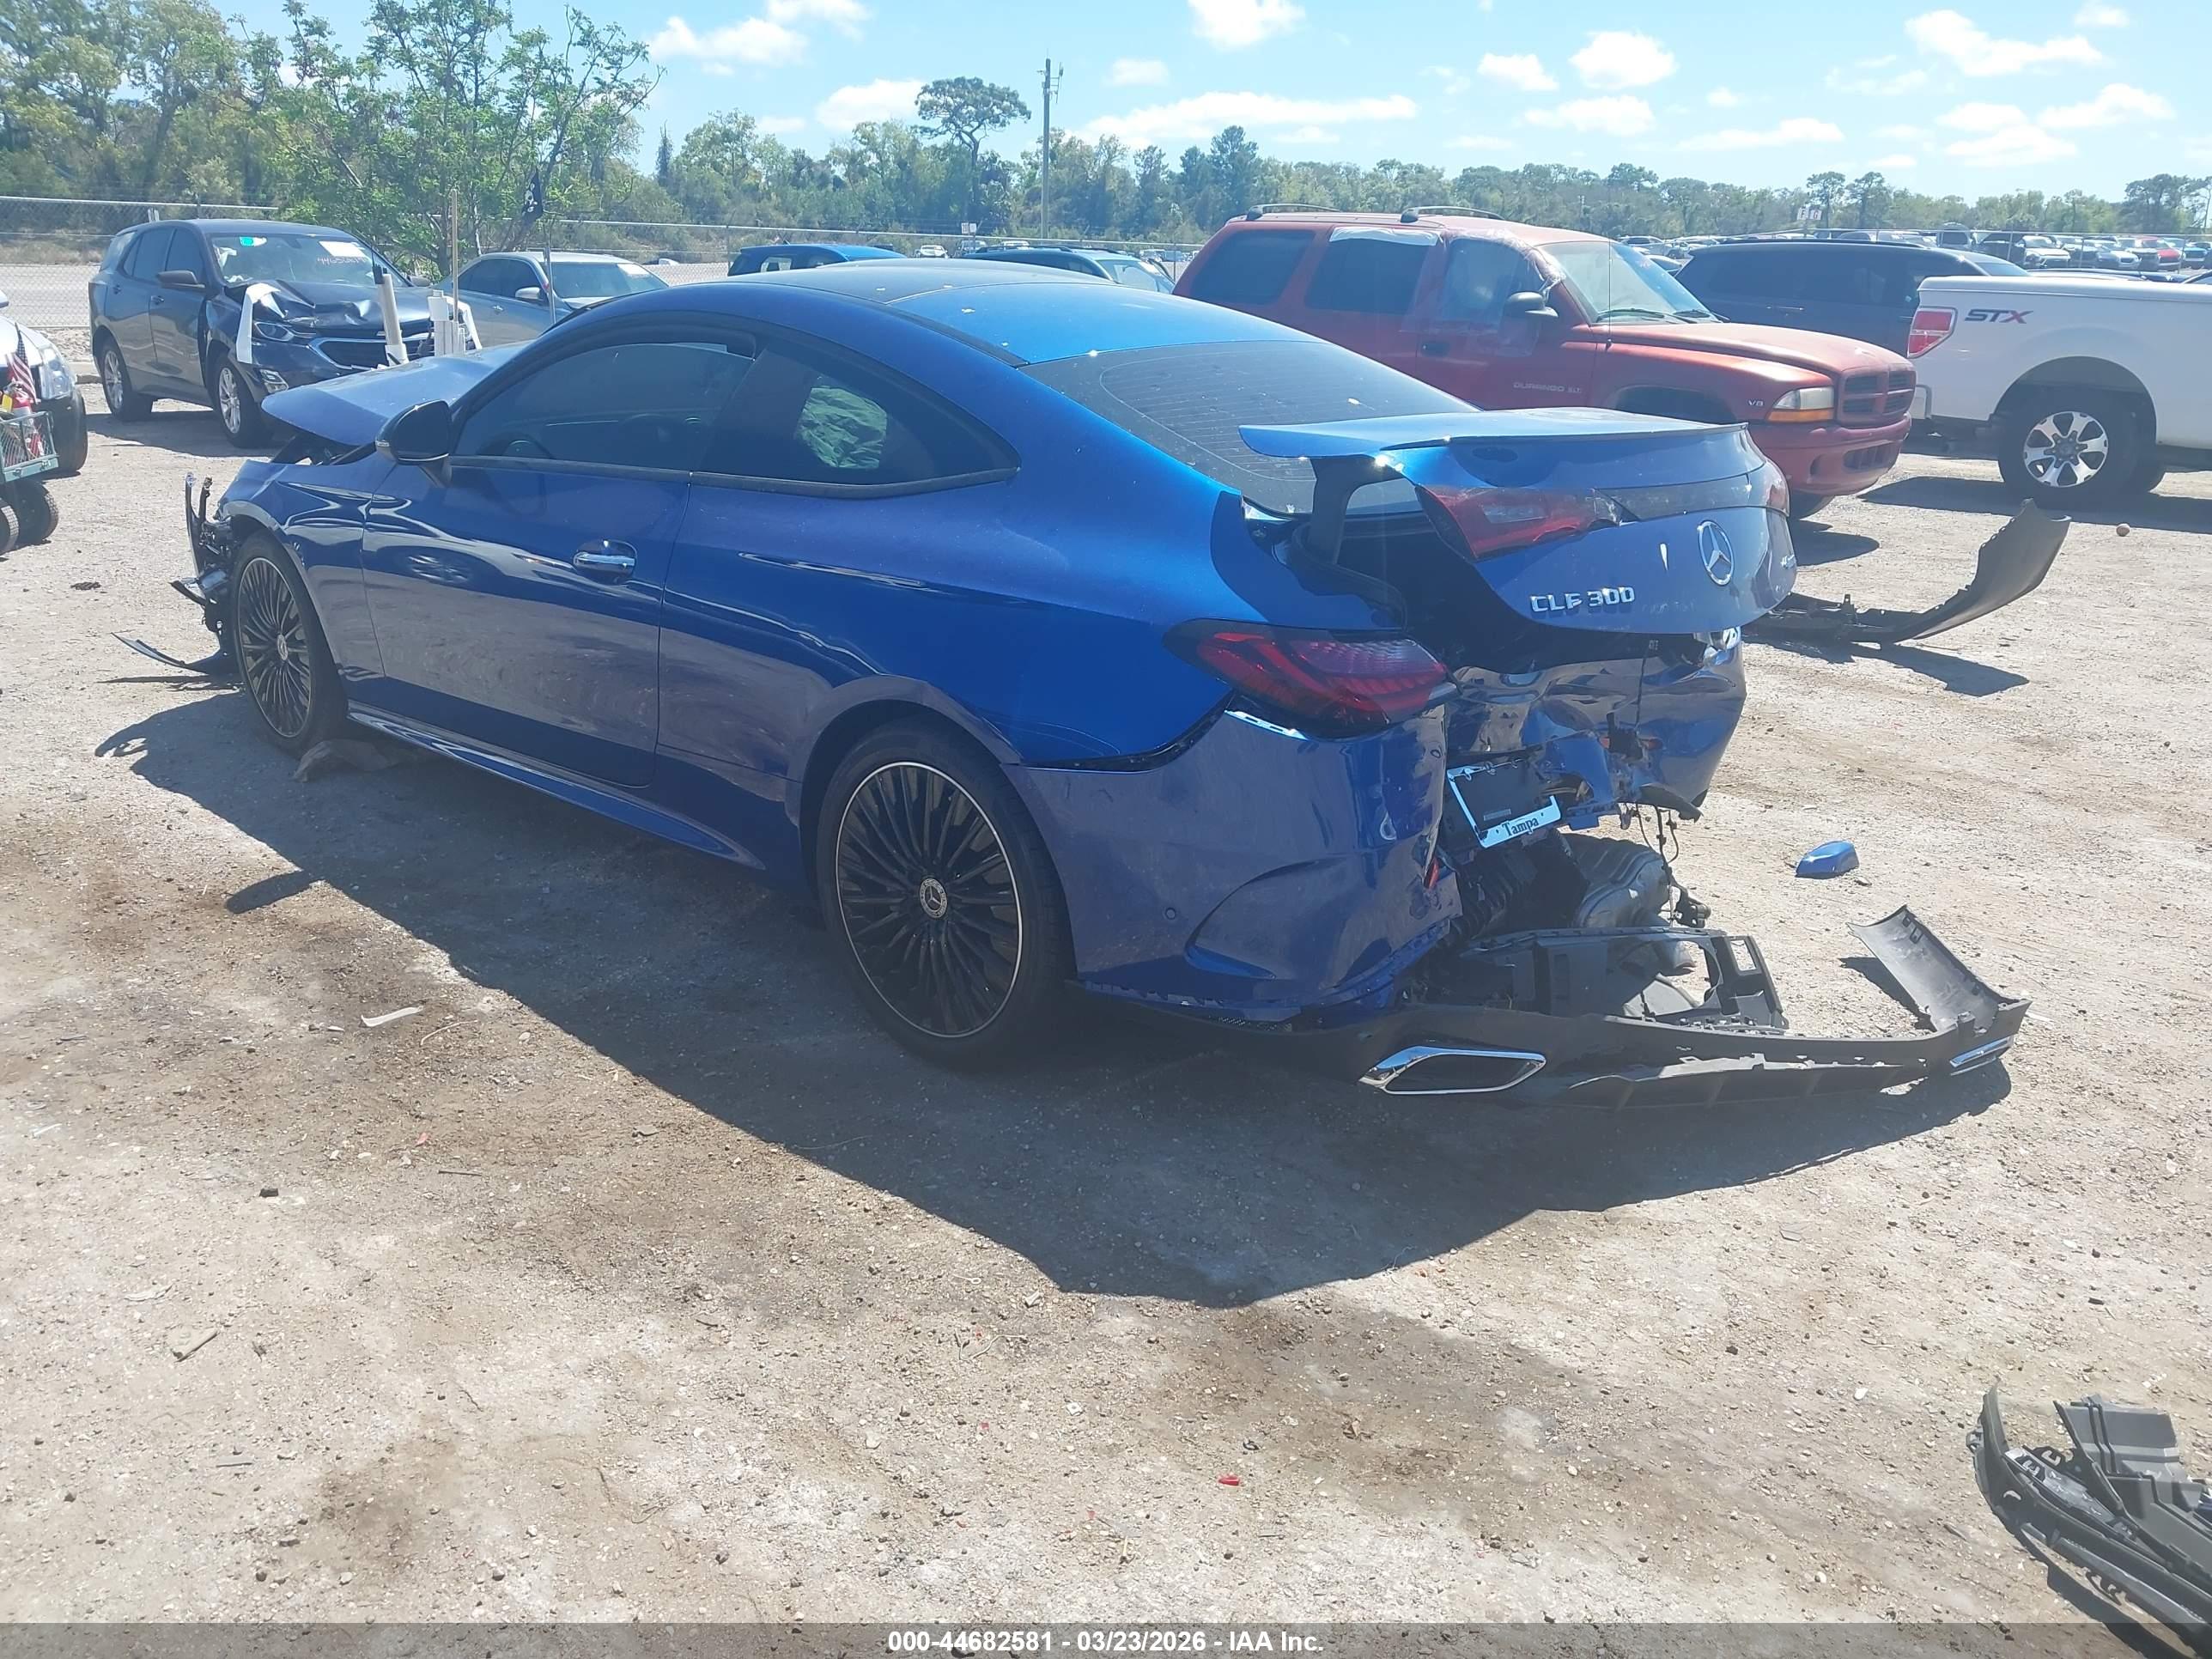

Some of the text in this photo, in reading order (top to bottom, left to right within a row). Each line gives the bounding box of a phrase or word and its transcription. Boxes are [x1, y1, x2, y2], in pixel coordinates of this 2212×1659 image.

[1964, 308, 2034, 324] STX
[1587, 586, 1635, 607] 300
[1502, 817, 1540, 836] Tampa
